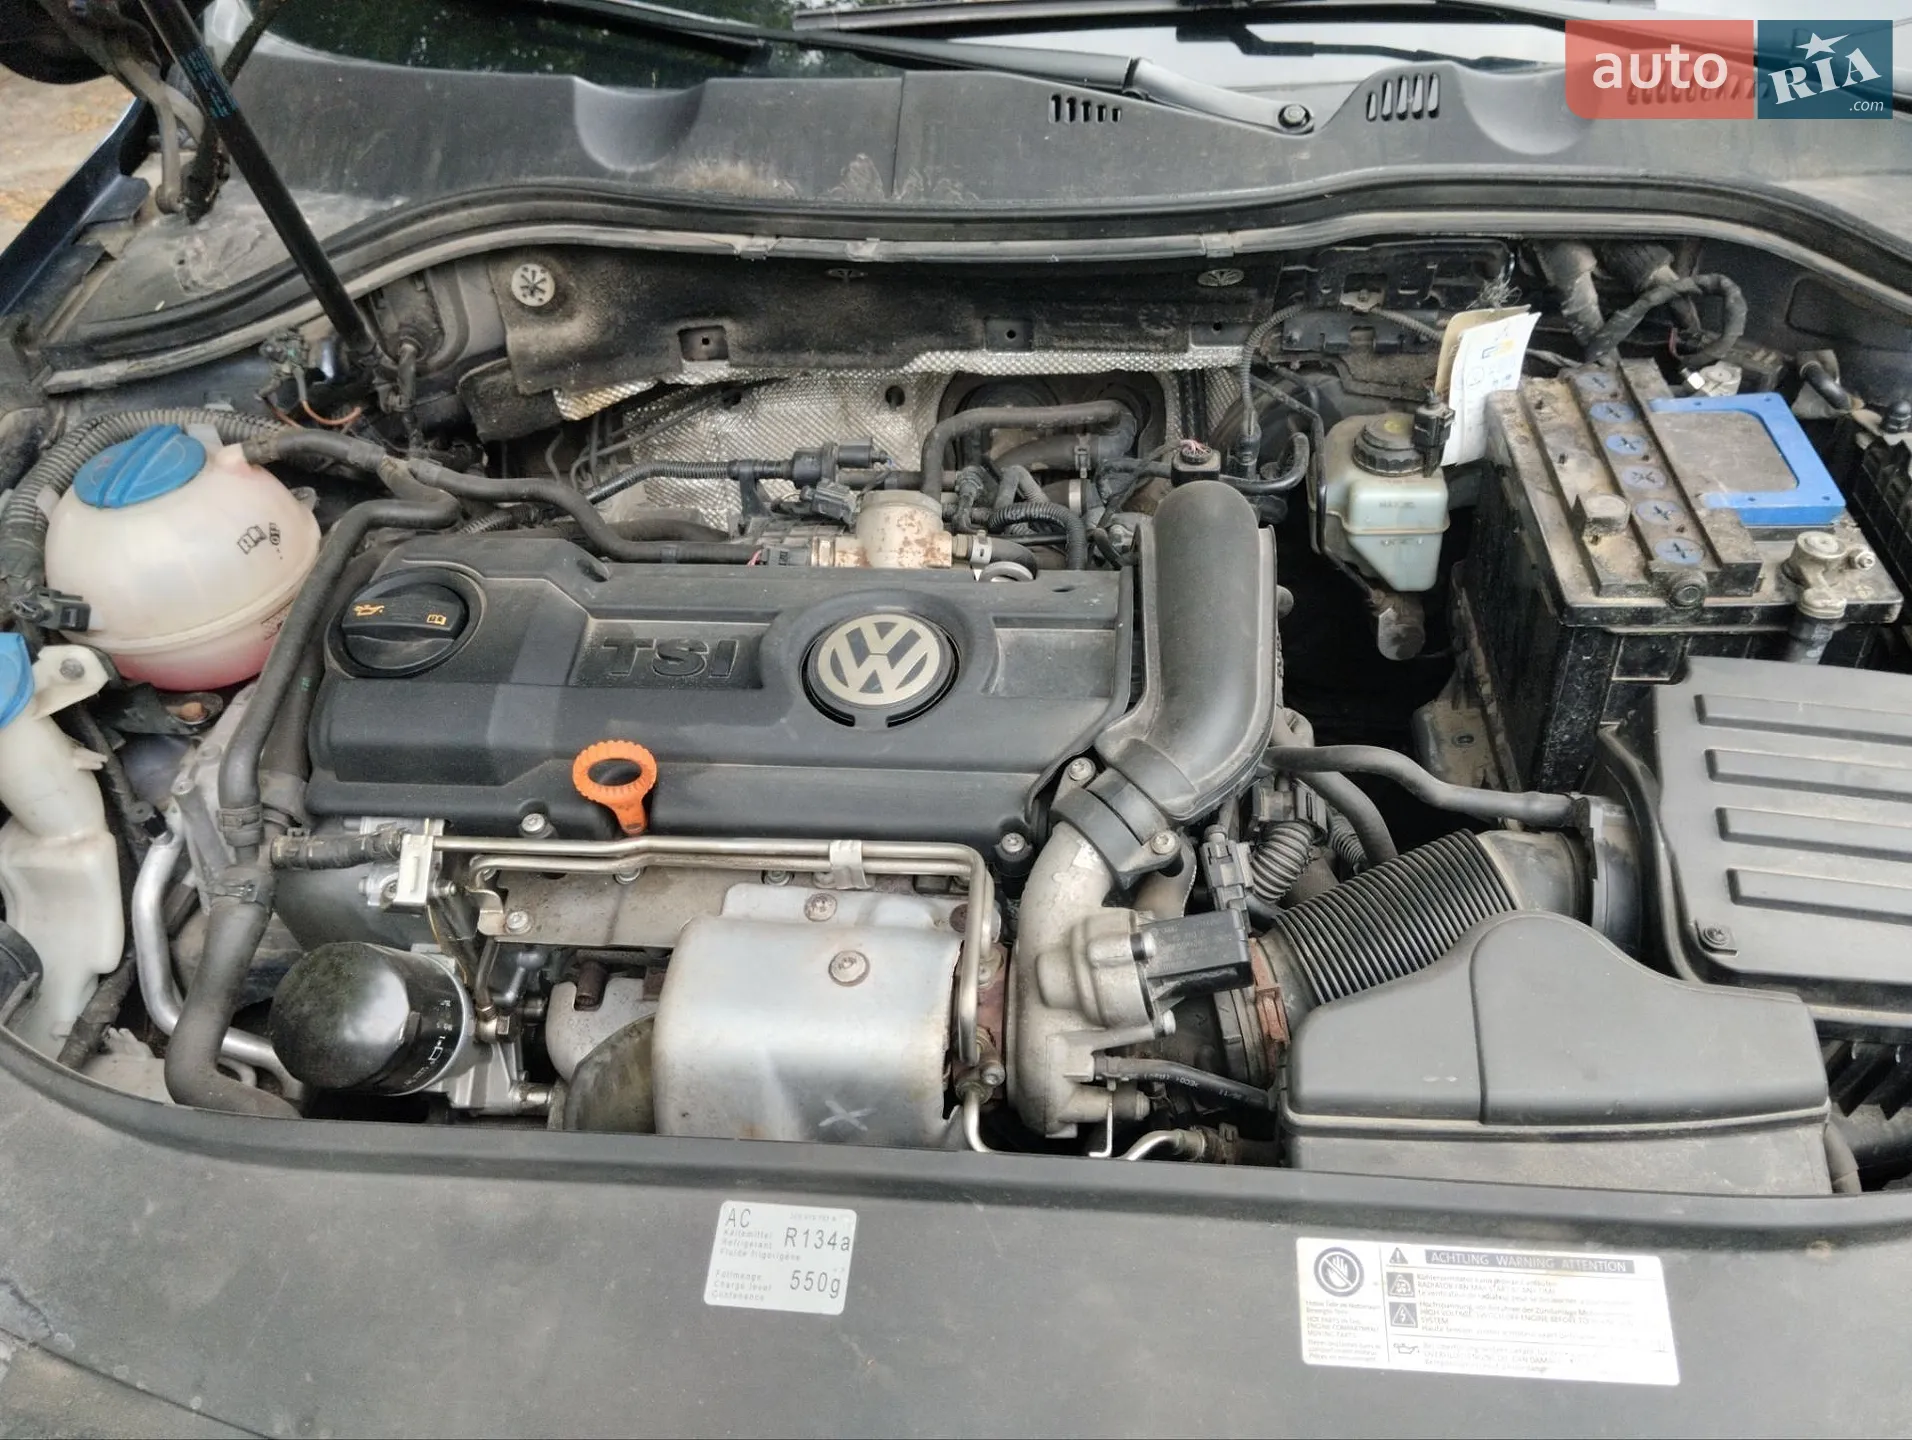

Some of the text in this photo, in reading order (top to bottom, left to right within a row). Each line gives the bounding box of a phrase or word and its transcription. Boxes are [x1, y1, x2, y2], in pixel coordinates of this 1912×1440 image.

[602, 636, 740, 679] TSI
[725, 1208, 751, 1228] AC
[784, 1226, 851, 1251] R134a
[1431, 1251, 1627, 1272] ACHTUNG WARNING ATTENTION
[790, 1269, 841, 1299] 550g
